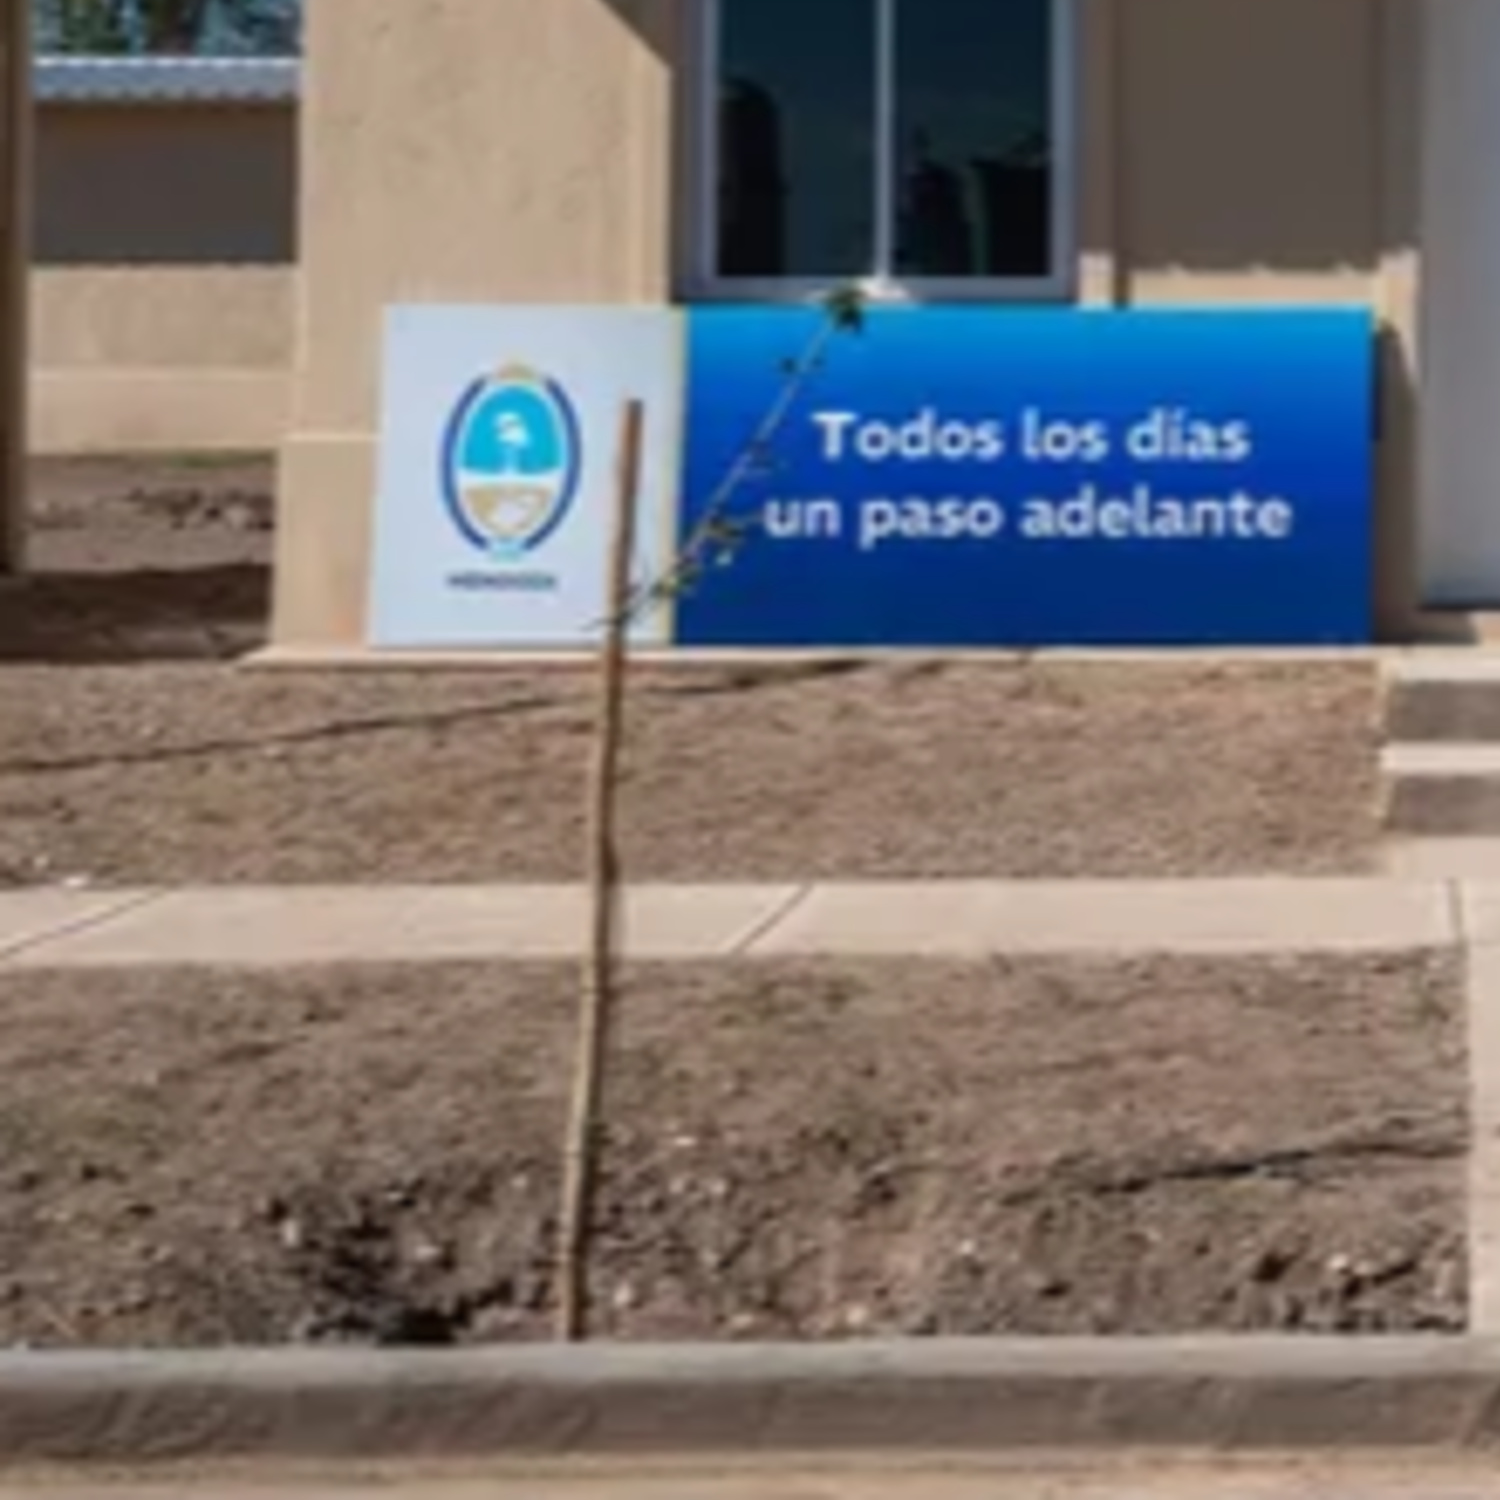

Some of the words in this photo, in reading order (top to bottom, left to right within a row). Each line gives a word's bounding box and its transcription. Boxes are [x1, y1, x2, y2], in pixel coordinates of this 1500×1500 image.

[811, 407, 1005, 461] Todos
[1022, 405, 1110, 462] los
[1126, 405, 1252, 462] días
[763, 498, 841, 538] un
[858, 498, 1005, 552] paso
[1018, 481, 1294, 538] adelante
